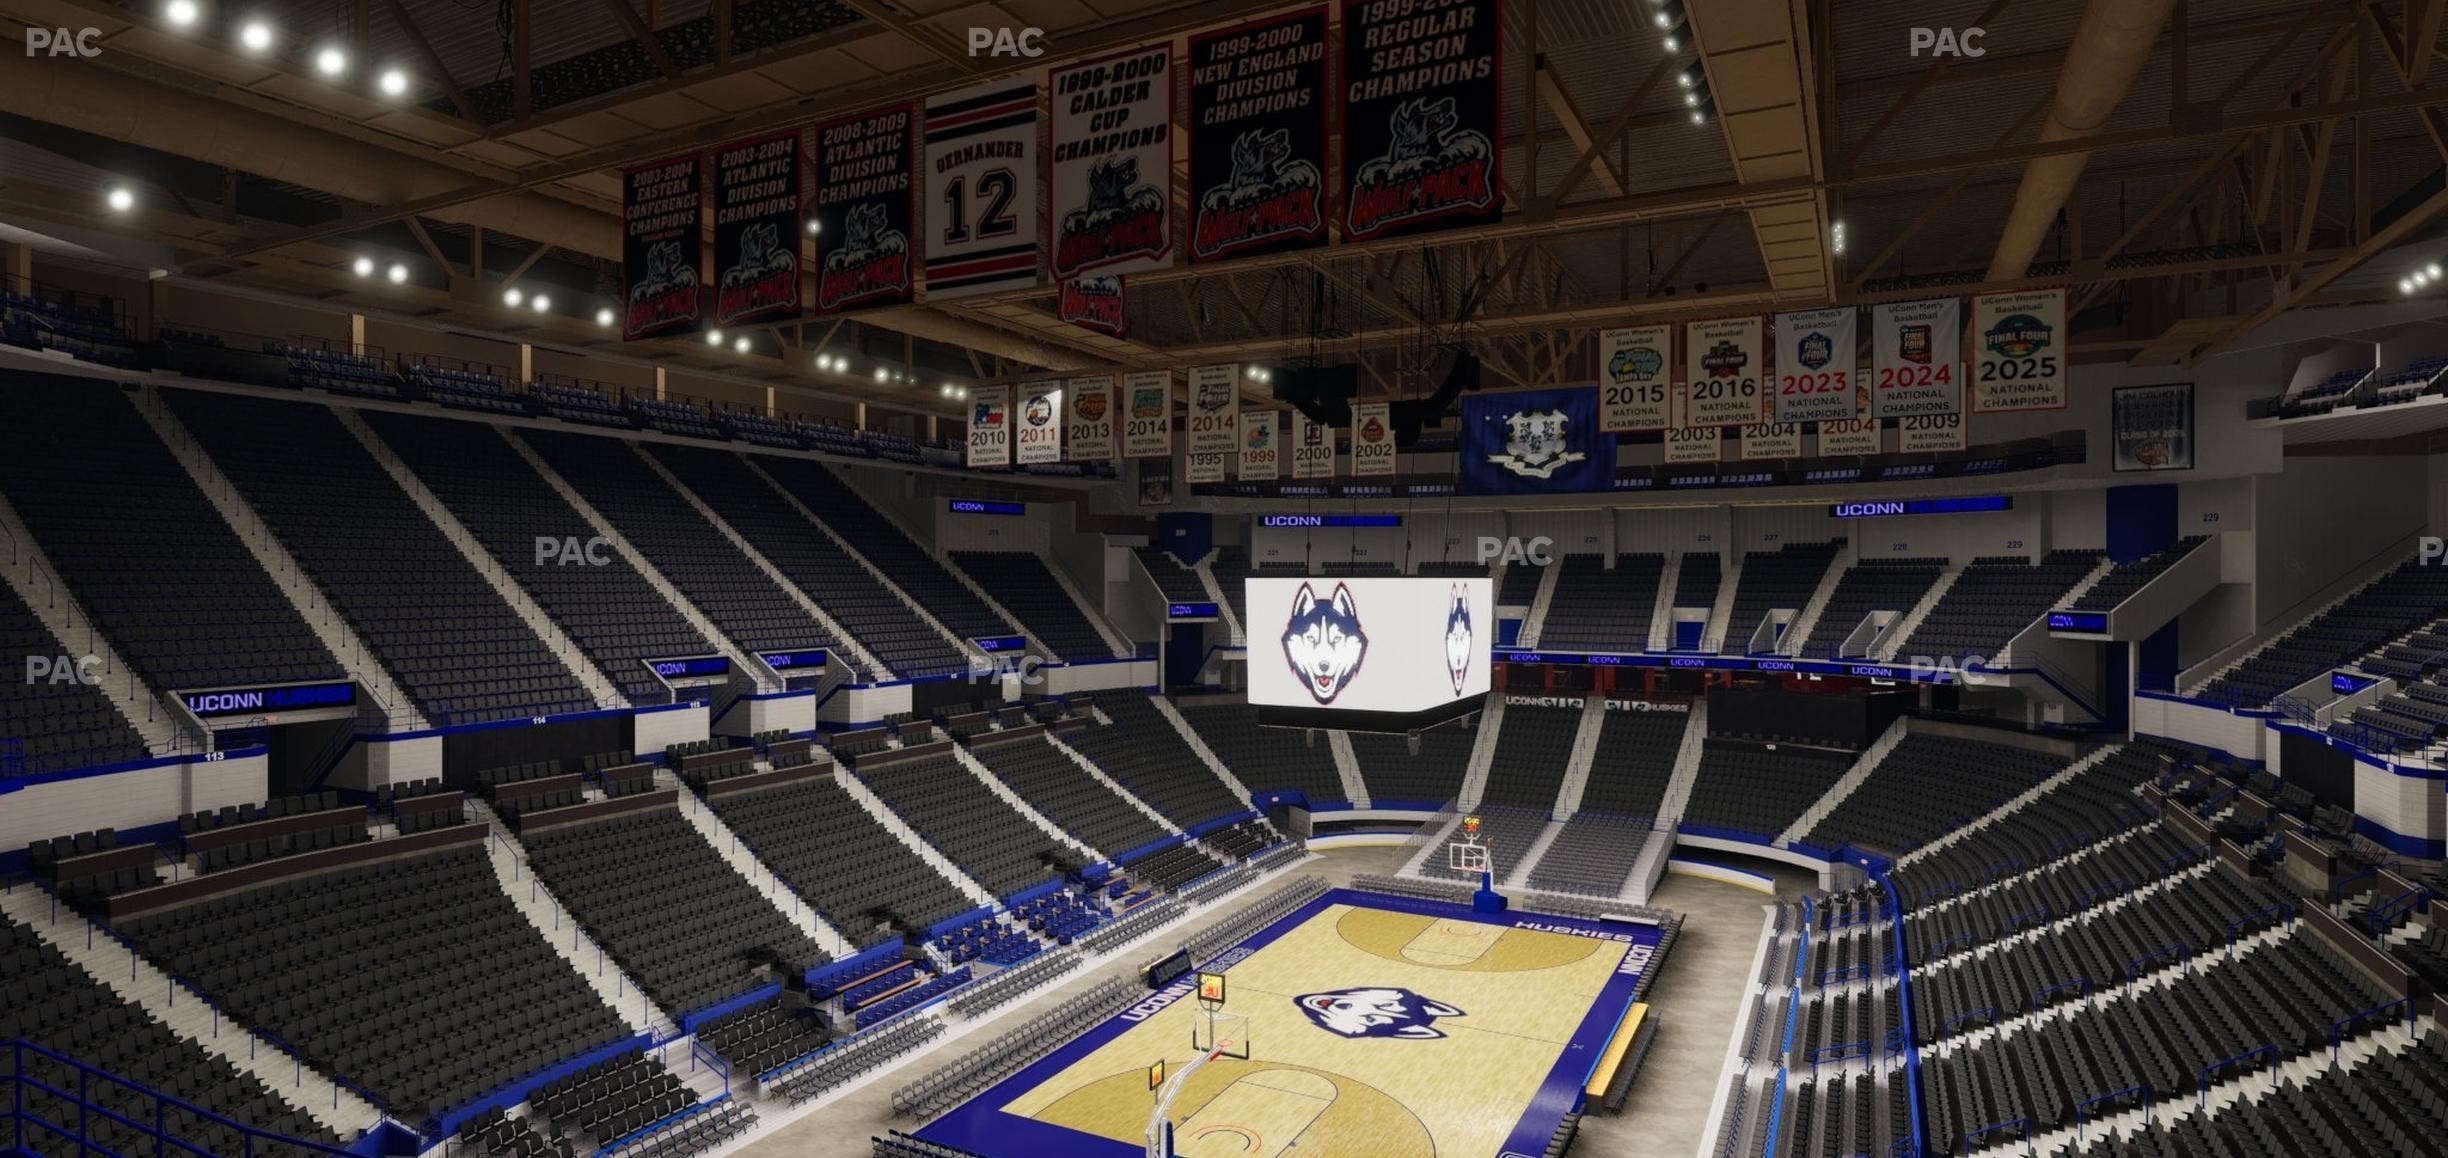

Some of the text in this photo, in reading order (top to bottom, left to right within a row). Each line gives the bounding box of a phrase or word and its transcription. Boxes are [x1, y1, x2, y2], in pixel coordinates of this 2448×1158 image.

[1364, 6, 1476, 50] REGULAR
[1210, 25, 1302, 61] 1999-2000
[1371, 34, 1468, 73] SEASON
[1193, 43, 1323, 87] NEW ENGLAND
[1217, 70, 1298, 102] DIVISION
[1349, 54, 1492, 104] CHAMPIONS
[1070, 81, 1150, 114] CALDER
[1203, 88, 1312, 125] CHAMPIONS
[1089, 109, 1130, 132] CUP
[824, 112, 906, 145] 2008-2009
[826, 133, 903, 164] ATLANTIC
[1054, 124, 1168, 162] CHAMPIONS
[936, 141, 1024, 174] GERNANDER
[722, 157, 792, 186] ATLANTIC
[829, 154, 898, 183] DIVISION
[728, 178, 788, 203] DIVISION
[819, 172, 909, 204] CHAMPIONS
[626, 192, 698, 221] CONFERENCE
[718, 194, 798, 224] CHAMPIONS
[944, 167, 1017, 245] 12
[630, 210, 695, 236] CHAMPIONS
[1981, 295, 2013, 306] UConn
[1888, 304, 1916, 314] UConn
[1880, 364, 1951, 389] 2024
[1980, 357, 2056, 382] 2025
[1693, 378, 1756, 400] 2016
[1782, 372, 1846, 395] 2023
[1990, 383, 2051, 395] NATIONAL
[1606, 385, 1664, 406] 2015
[1887, 390, 1944, 400] NATIONAL
[1984, 396, 2058, 408] CHAMPIONS
[1700, 402, 1752, 412] NATIONAL
[1788, 398, 1843, 408] NATIONAL
[1882, 402, 1950, 413] CHAMPIONS
[1612, 408, 1660, 418] NATIONAL
[1695, 413, 1756, 424] CHAMPIONS
[1784, 409, 1848, 420] CHAMPIONS
[1127, 420, 1167, 436] 2014
[1192, 415, 1234, 432] 2014
[1607, 420, 1665, 429] CHAMPIONS
[1824, 420, 1876, 434] 2004
[1904, 413, 1960, 430] 2009
[1020, 428, 1056, 444] 2011
[1072, 424, 1110, 440] 2013
[1669, 427, 1716, 442] 2003
[1746, 423, 1795, 438] 2004
[1911, 432, 1956, 440] NATIONAL
[971, 431, 1006, 446] 2010
[1752, 440, 1792, 448] NATIONAL
[1829, 436, 1871, 444] NATIONAL
[1906, 442, 1960, 450] CHAMPIONS
[1296, 447, 1332, 461] 2000
[1355, 444, 1392, 457] 2002
[1674, 443, 1712, 451] NATIONAL
[1747, 448, 1796, 456] CHAMPIONS
[1824, 446, 1876, 454] CHAMPIONS
[1190, 453, 1221, 466] 1995
[1242, 450, 1276, 463] 1999
[1670, 452, 1716, 460] CHAMPIONS
[952, 502, 984, 512] UCONN
[1837, 502, 1905, 517] UCONN
[1264, 516, 1321, 526] UCONN
[1510, 653, 1540, 662] UCONN
[1588, 656, 1620, 664] UCONN
[1670, 658, 1705, 667] UCONN
[1758, 662, 1794, 670] UCONN
[1852, 666, 1892, 677] UCONN
[190, 692, 262, 712] UCONN
[1506, 696, 1541, 705] UCONN
[204, 752, 225, 762] 113
[1515, 921, 1634, 942] HUSKIES
[1617, 944, 1656, 976] UCONN
[1120, 981, 1194, 1022] UCONN
